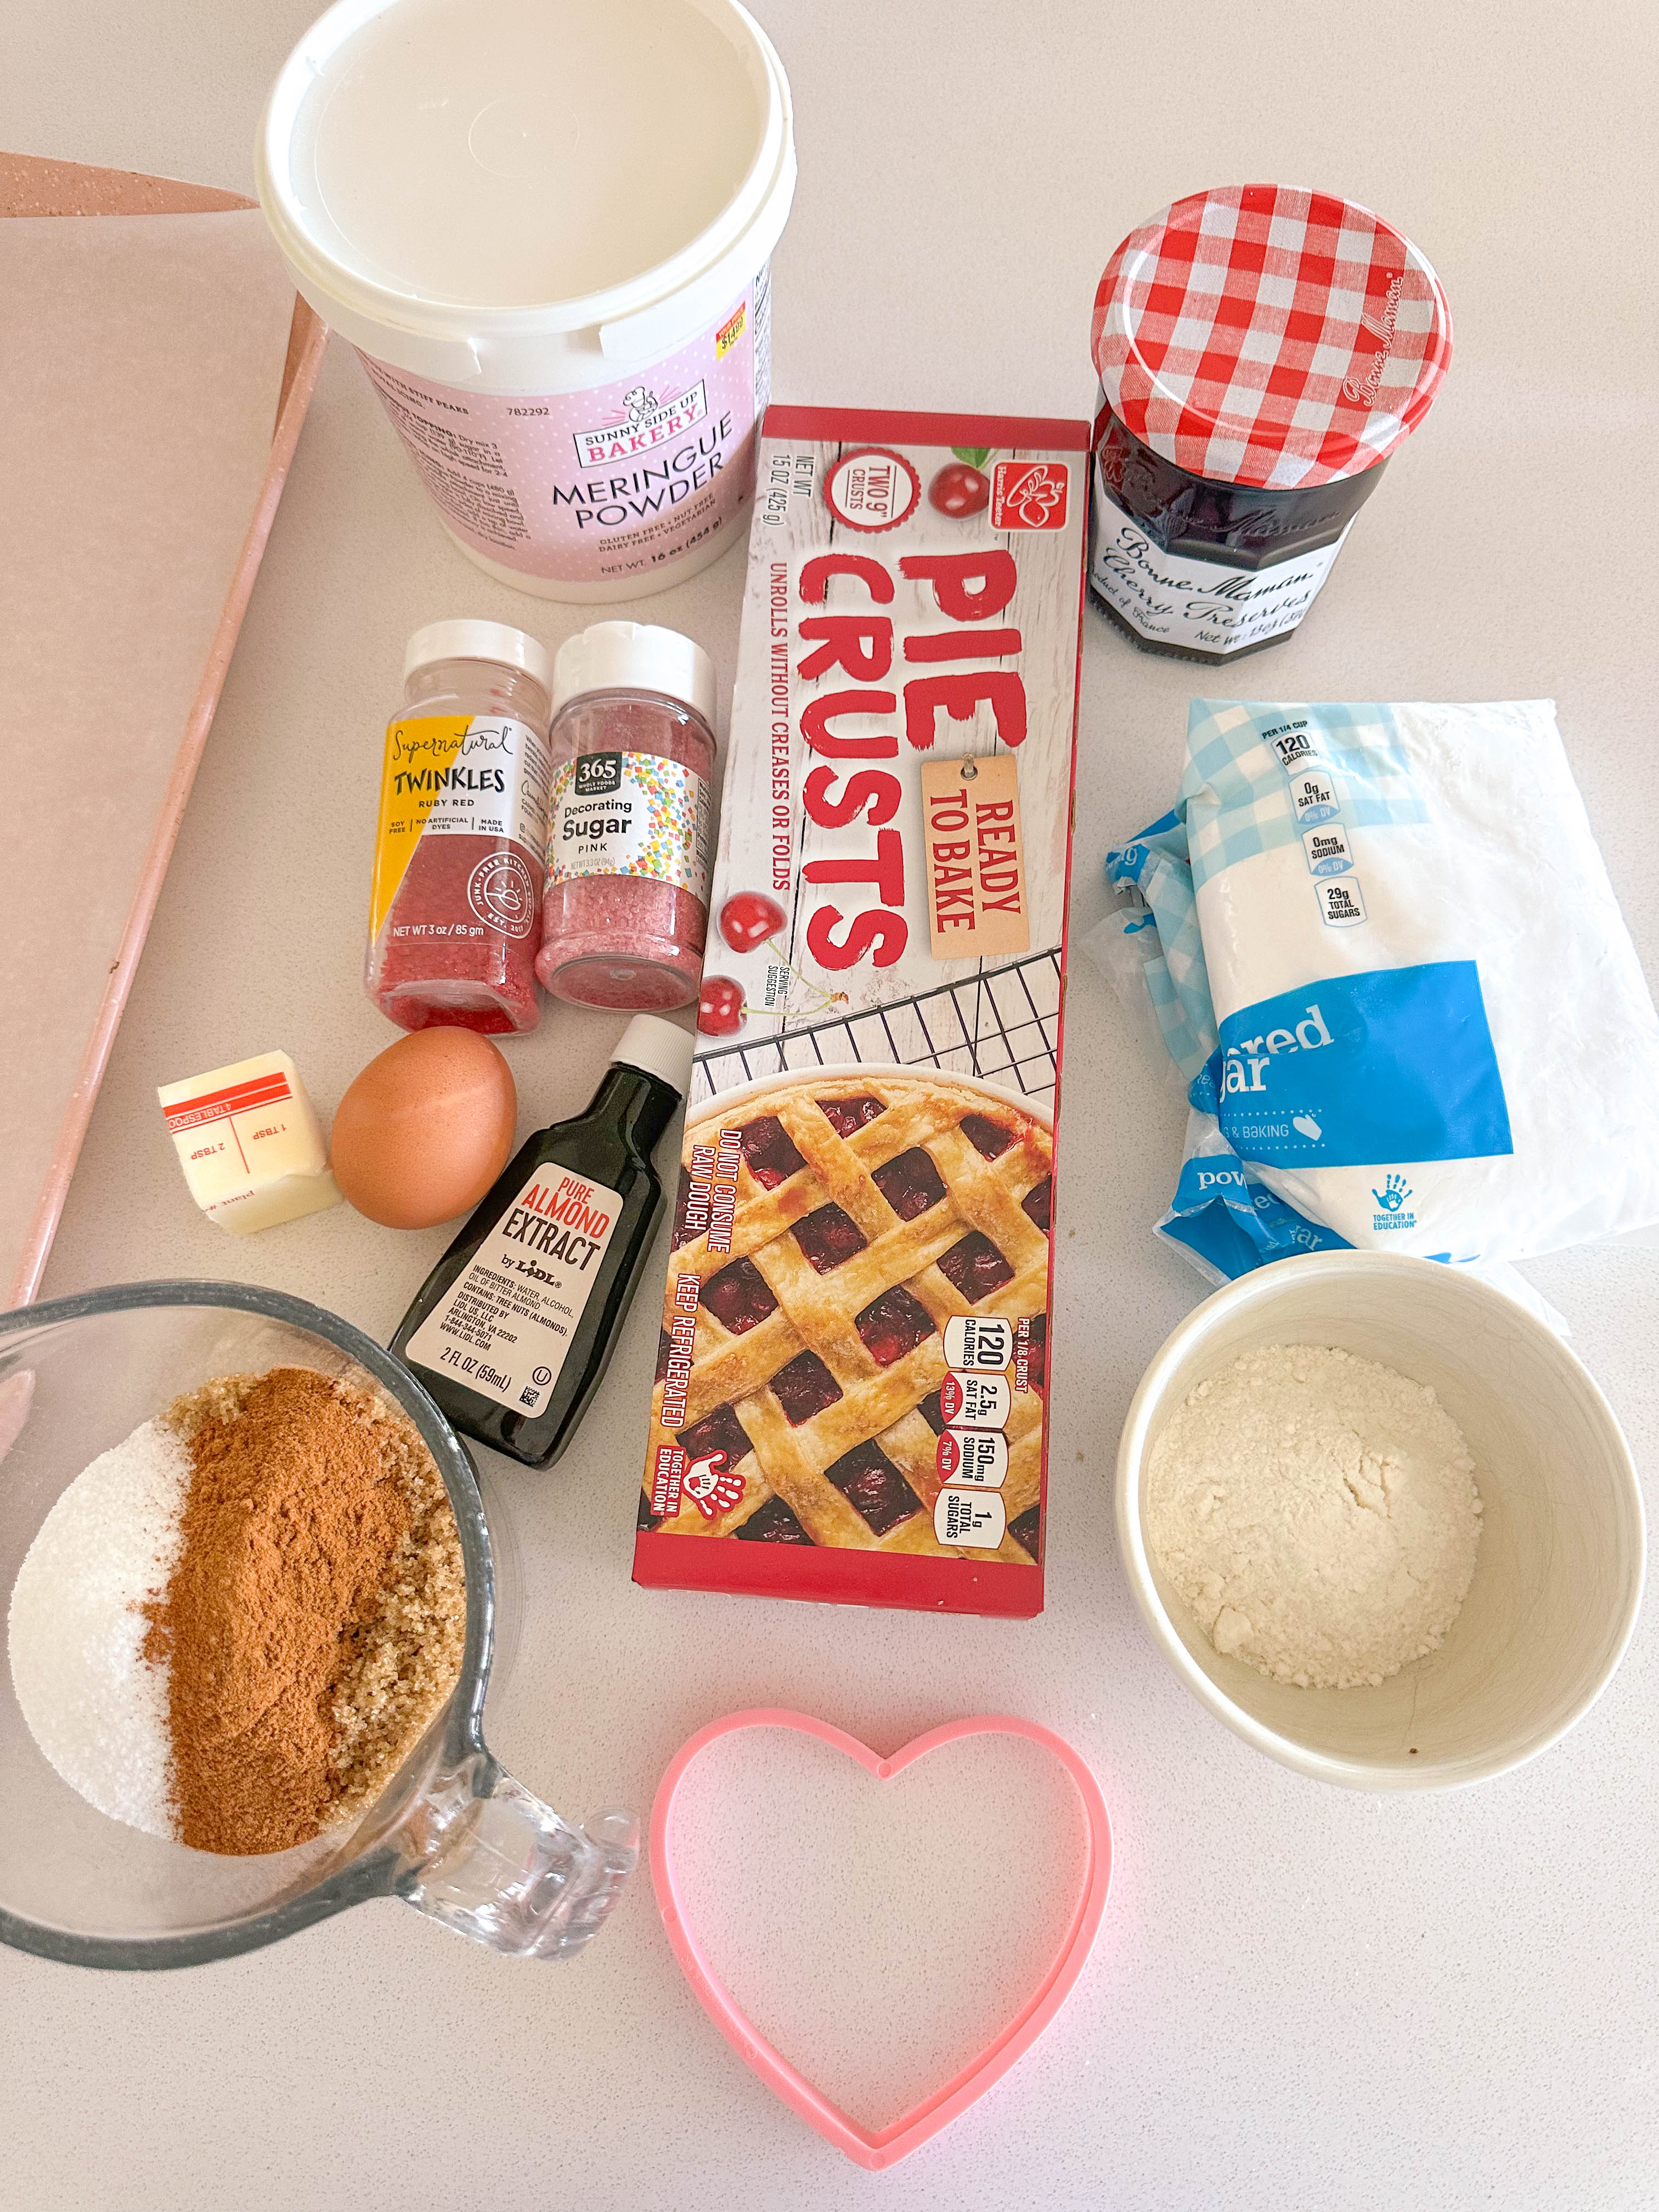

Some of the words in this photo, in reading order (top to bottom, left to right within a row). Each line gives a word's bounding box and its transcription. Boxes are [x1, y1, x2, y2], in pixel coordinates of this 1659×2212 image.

[1342, 349, 1389, 407] Bonne
[506, 407, 550, 416] 782292
[585, 422, 641, 445] SUNNY
[645, 405, 677, 428] SIDE
[679, 391, 699, 409] UP
[588, 404, 698, 462] BAKERY
[553, 410, 733, 506] MERINGUE
[772, 455, 791, 467] 15
[794, 455, 815, 477] NET
[575, 452, 724, 530] POWDER
[770, 470, 790, 484] OZ
[793, 480, 812, 497] WT
[850, 469, 866, 510] CRUSTS
[867, 465, 890, 499] TWO
[996, 466, 1007, 496] Harris
[766, 488, 787, 512] (425
[995, 496, 1006, 527] Teeter
[599, 542, 629, 552] DAIRY
[632, 534, 656, 547] FREE
[663, 498, 716, 534] VEGETARIAN
[600, 532, 640, 545] GLUTEN
[643, 522, 666, 536] FREE
[674, 507, 692, 522] NUT
[694, 493, 714, 511] FREE
[763, 515, 785, 527] g)
[1116, 527, 1193, 591] Bonne
[1197, 572, 1313, 602] Maman
[770, 562, 788, 638] UNROLLS
[1103, 548, 1173, 616] Cherry
[1183, 589, 1311, 628] Preserves
[898, 549, 1028, 751] PIE
[771, 643, 789, 717] WITHOUT
[393, 725, 514, 764] Supernatural
[1262, 728, 1278, 740] PER
[1279, 724, 1291, 732] 1/4
[1293, 720, 1308, 729] CUP
[1276, 734, 1310, 755] 120
[578, 758, 617, 783] 365
[771, 721, 790, 801] CREASES
[797, 552, 909, 972] CRUSTS
[1282, 750, 1318, 766] CALORIES
[394, 766, 506, 796] TWINKLES
[579, 781, 596, 789] WHOLE
[1304, 782, 1319, 794] 0g
[419, 799, 448, 808] RUBY
[565, 799, 632, 819] Decorating
[930, 789, 969, 832] TO
[1298, 795, 1313, 808] SAT
[1316, 791, 1330, 803] FAT
[1304, 811, 1319, 822] 0%
[1319, 806, 1330, 817] DV
[562, 818, 632, 841] Sugar
[772, 805, 790, 830] OR
[578, 842, 608, 854] PINK
[975, 799, 1022, 914] READY
[1311, 844, 1345, 859] SODIUM
[1312, 837, 1338, 848] 0mg
[772, 835, 791, 890] FOLDS
[1318, 865, 1332, 874] 0%
[1332, 860, 1344, 871] DV
[933, 842, 975, 934] BAKE
[1327, 887, 1350, 900] 29g
[1327, 908, 1361, 919] SUGARS
[1328, 899, 1355, 910] TOTAL
[393, 926, 410, 937] NET
[413, 925, 428, 935] WT
[429, 924, 435, 935] 3
[437, 926, 447, 935] oz
[455, 925, 467, 935] 85
[469, 926, 484, 937] gm
[764, 965, 778, 1007] SUGGESTION
[777, 967, 790, 995] SERVING
[252, 1126, 280, 1140] TBSP
[281, 1124, 287, 1132] 1
[720, 1128, 742, 1149] DO
[191, 1146, 218, 1160] TBSP
[691, 1144, 716, 1180] RAW
[716, 1152, 740, 1181] NOT
[557, 1176, 595, 1205] PURE
[521, 1183, 610, 1239] ALMOND
[684, 1181, 712, 1231] DOUGH
[707, 1184, 737, 1254] CONSUME
[1373, 1213, 1406, 1222] TOGETHER
[1407, 1212, 1414, 1220] IN
[502, 1207, 601, 1271] EXTRACT
[1373, 1220, 1414, 1231] EDUCATION
[501, 1254, 516, 1269] by
[457, 1291, 500, 1316] DISTRIBUTED
[499, 1310, 510, 1320] BY
[469, 1272, 479, 1283] OIL
[480, 1277, 491, 1286] OF
[489, 1281, 512, 1297] BITTER
[511, 1293, 541, 1311] ALMOND.
[472, 1264, 516, 1289] INGREDIENTS:
[517, 1284, 540, 1301] WATER,
[540, 1296, 574, 1318] ALCOHOL,
[675, 1273, 701, 1312] KEEP
[453, 1299, 468, 1312] LIDL
[469, 1305, 479, 1317] US,
[481, 1311, 495, 1323] LLC
[463, 1282, 495, 1301] CONTAINS:
[495, 1296, 514, 1309] TREE
[511, 1303, 531, 1317] NUTS
[529, 1311, 568, 1337] (ALMONDS).
[439, 1322, 492, 1351] WWW.LIDL.COM
[444, 1314, 493, 1342] 1-844-344-5071
[448, 1307, 486, 1330] ARLINGTON,
[488, 1324, 496, 1334] VA
[496, 1329, 518, 1344] 22202
[1018, 1317, 1030, 1338] PER
[963, 1319, 977, 1366] CALORIES
[977, 1324, 1005, 1365] 120
[1017, 1341, 1029, 1356] 1/8
[440, 1347, 451, 1361] 2
[448, 1350, 462, 1367] FL
[461, 1356, 479, 1374] OZ
[475, 1364, 512, 1393] (59mL)
[661, 1316, 696, 1427] REFRIGERATED
[1015, 1358, 1029, 1393] CRUST
[945, 1381, 956, 1400] 13%
[966, 1379, 978, 1399] SAT
[978, 1385, 997, 1416] 2.5g
[944, 1402, 955, 1414] DV
[965, 1402, 977, 1420] FAT
[942, 1441, 952, 1456] 7%
[962, 1437, 975, 1479] SODIUM
[974, 1437, 995, 1482] 150mg
[668, 1449, 685, 1499] TOGETHER
[941, 1458, 952, 1471] DV
[653, 1448, 667, 1513] EDUCATION
[666, 1500, 679, 1513] IN
[946, 1495, 960, 1538] SUGARS
[960, 1502, 972, 1533] TOTAL
